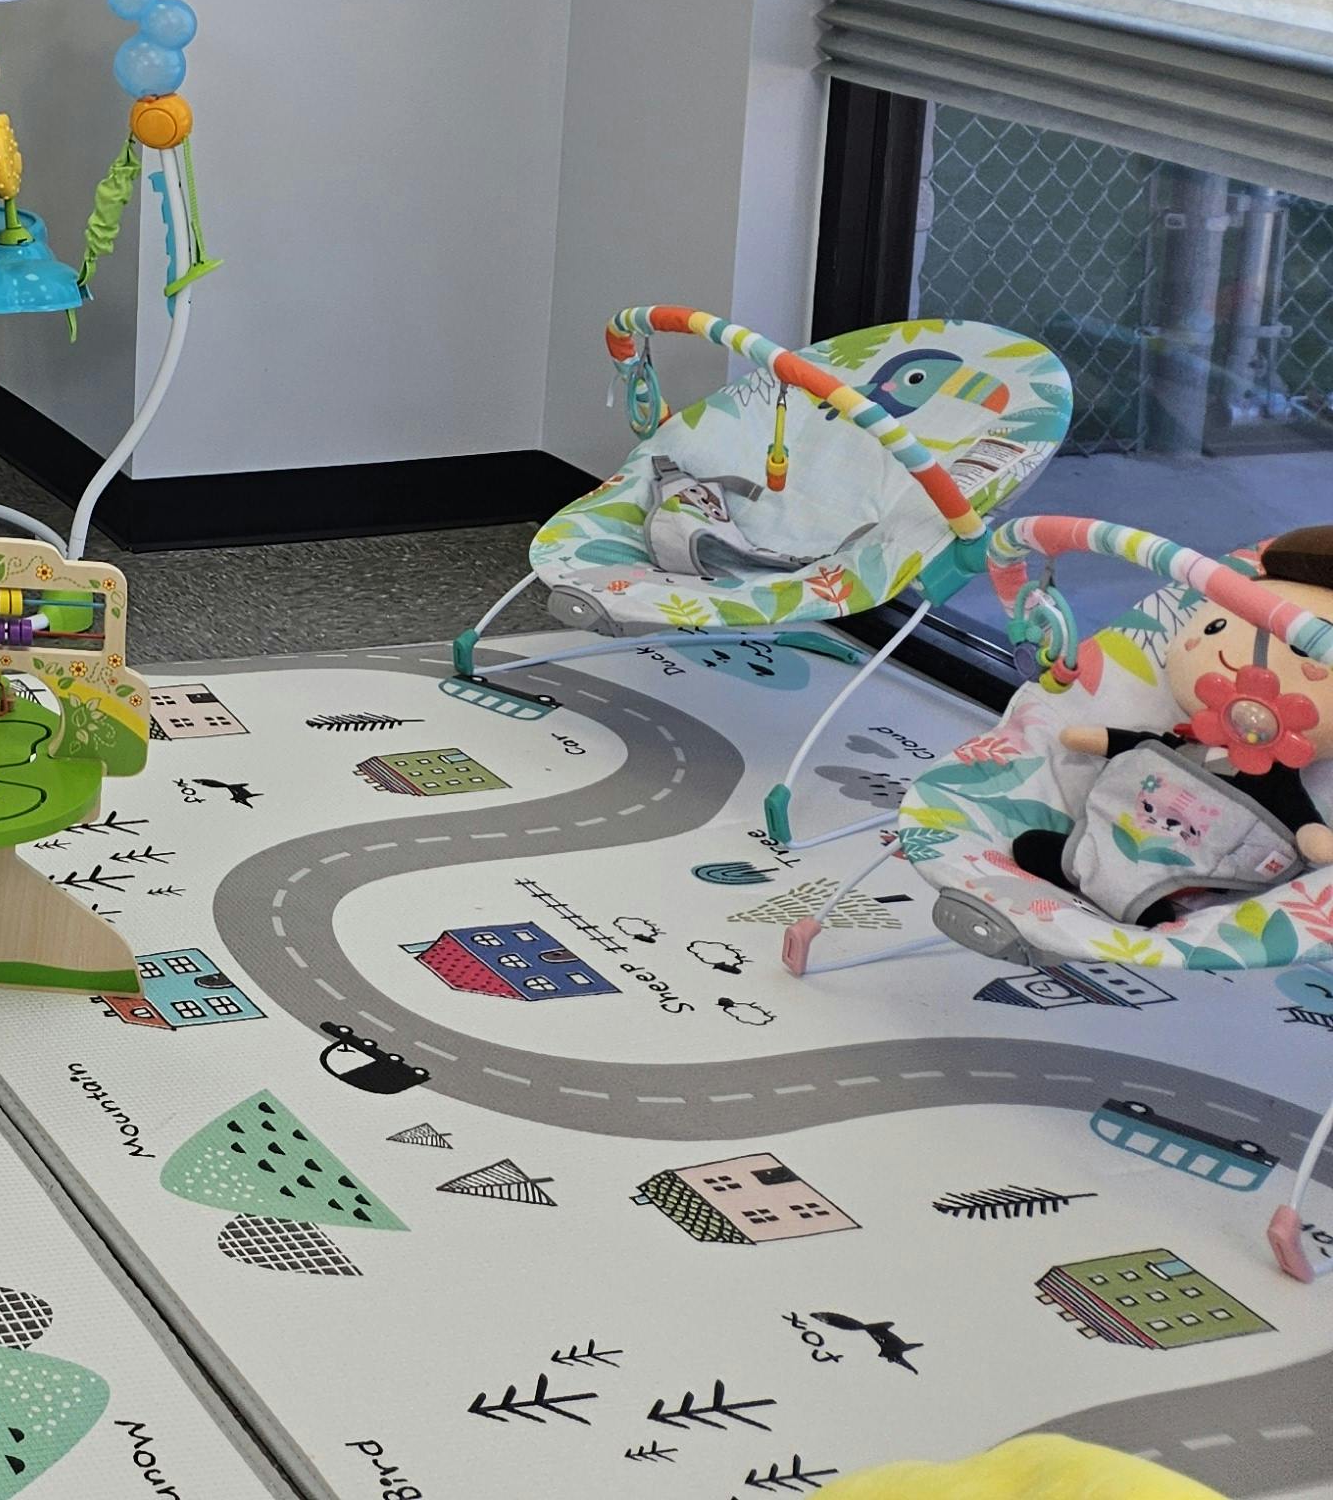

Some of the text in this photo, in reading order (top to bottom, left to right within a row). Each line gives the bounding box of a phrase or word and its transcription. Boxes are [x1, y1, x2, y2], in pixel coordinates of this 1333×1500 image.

[636, 646, 686, 676] Duck
[551, 732, 586, 755] Car
[868, 726, 935, 760] Cloud
[747, 828, 801, 869] Tree
[619, 963, 695, 1014] Sheep
[67, 1063, 156, 1158] Mountain
